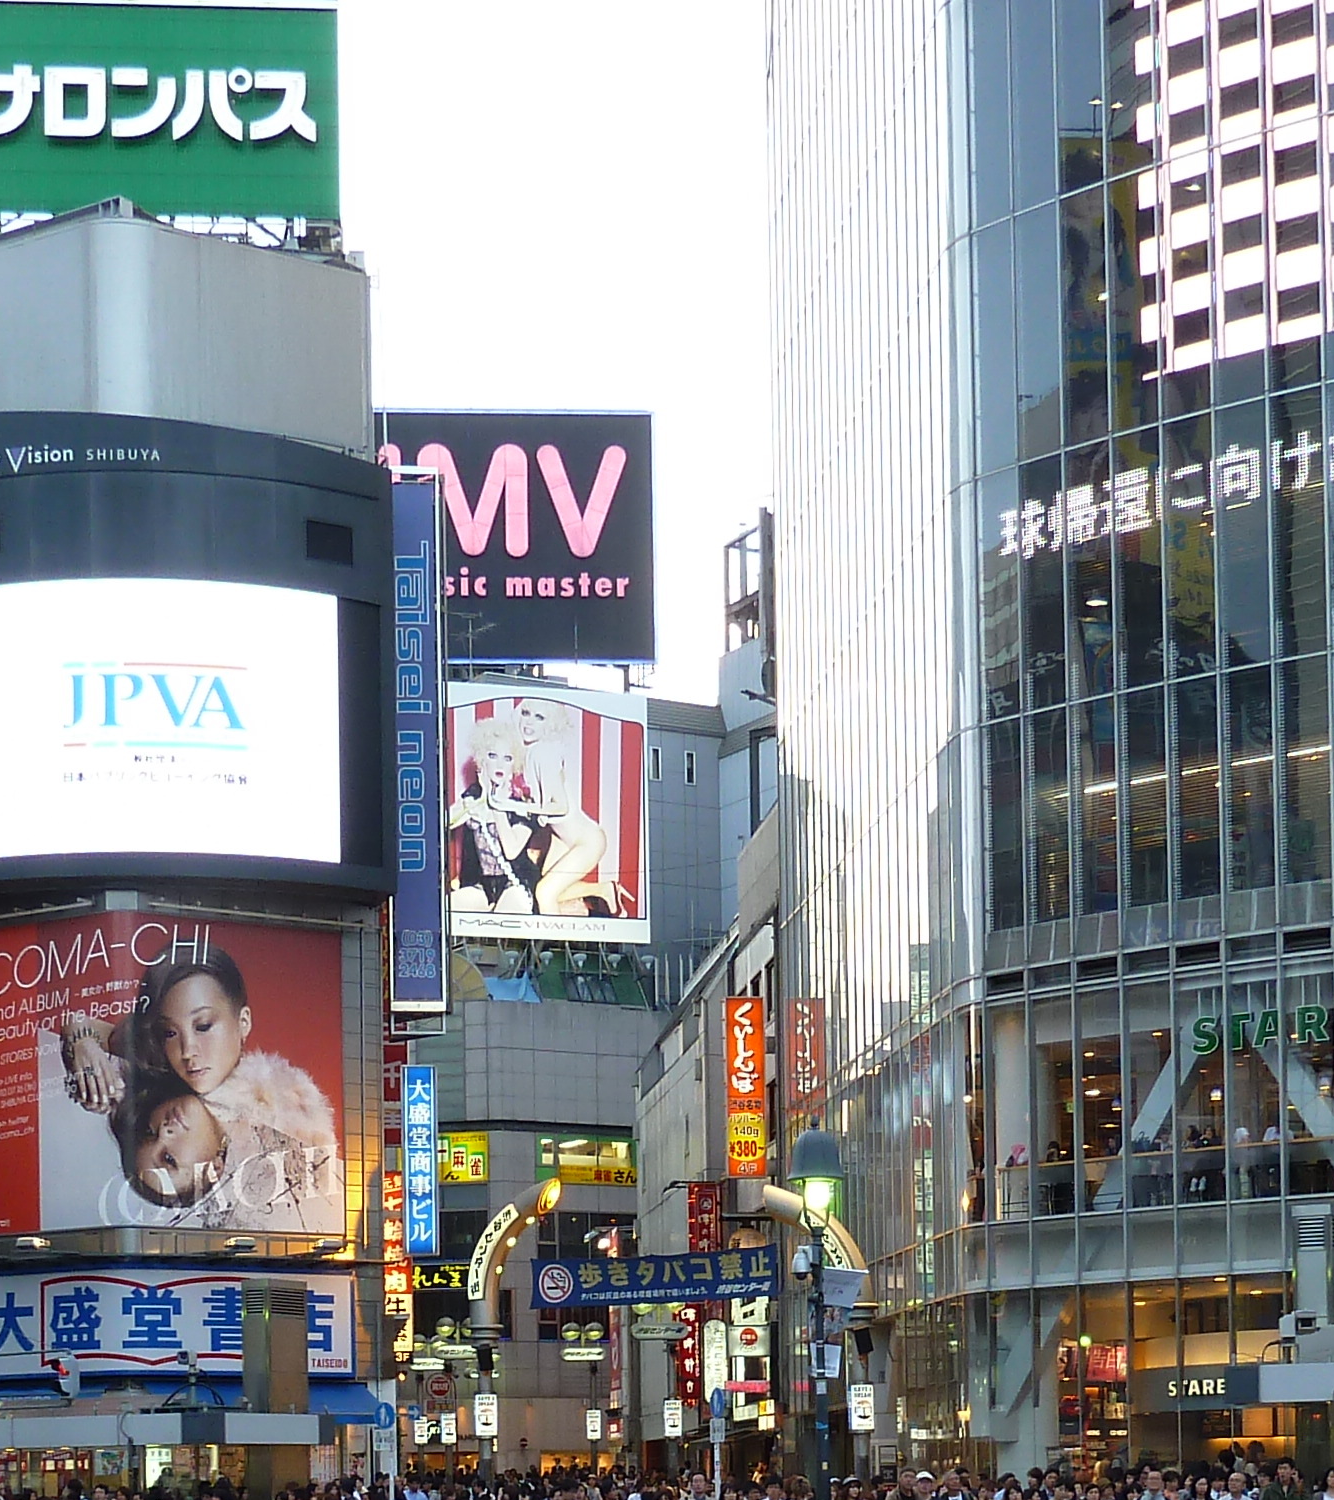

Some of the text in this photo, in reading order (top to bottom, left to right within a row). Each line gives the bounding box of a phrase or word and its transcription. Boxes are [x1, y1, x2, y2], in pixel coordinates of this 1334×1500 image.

[5, 445, 75, 474] Vision
[86, 448, 161, 463] SHIBUYA
[378, 443, 627, 558] MV
[505, 572, 631, 598] master
[64, 673, 246, 730] JPVA
[392, 540, 430, 873] Taisei neon
[399, 946, 435, 963] 3719
[398, 961, 436, 979] 2468
[18, 987, 71, 1015] ALBUM
[41, 1014, 58, 1031] or
[61, 1008, 86, 1027] the
[89, 995, 151, 1020] Beast?
[0, 1047, 34, 1066] STORES
[733, 1125, 760, 1138] 140g
[408, 1078, 432, 1243] 大盛堂商事ビル
[736, 1162, 759, 1175] 4F
[578, 1250, 773, 1290] 歩きタバコ禁止
[310, 1357, 349, 1369] TAISEIDO
[394, 1351, 410, 1362] 3F
